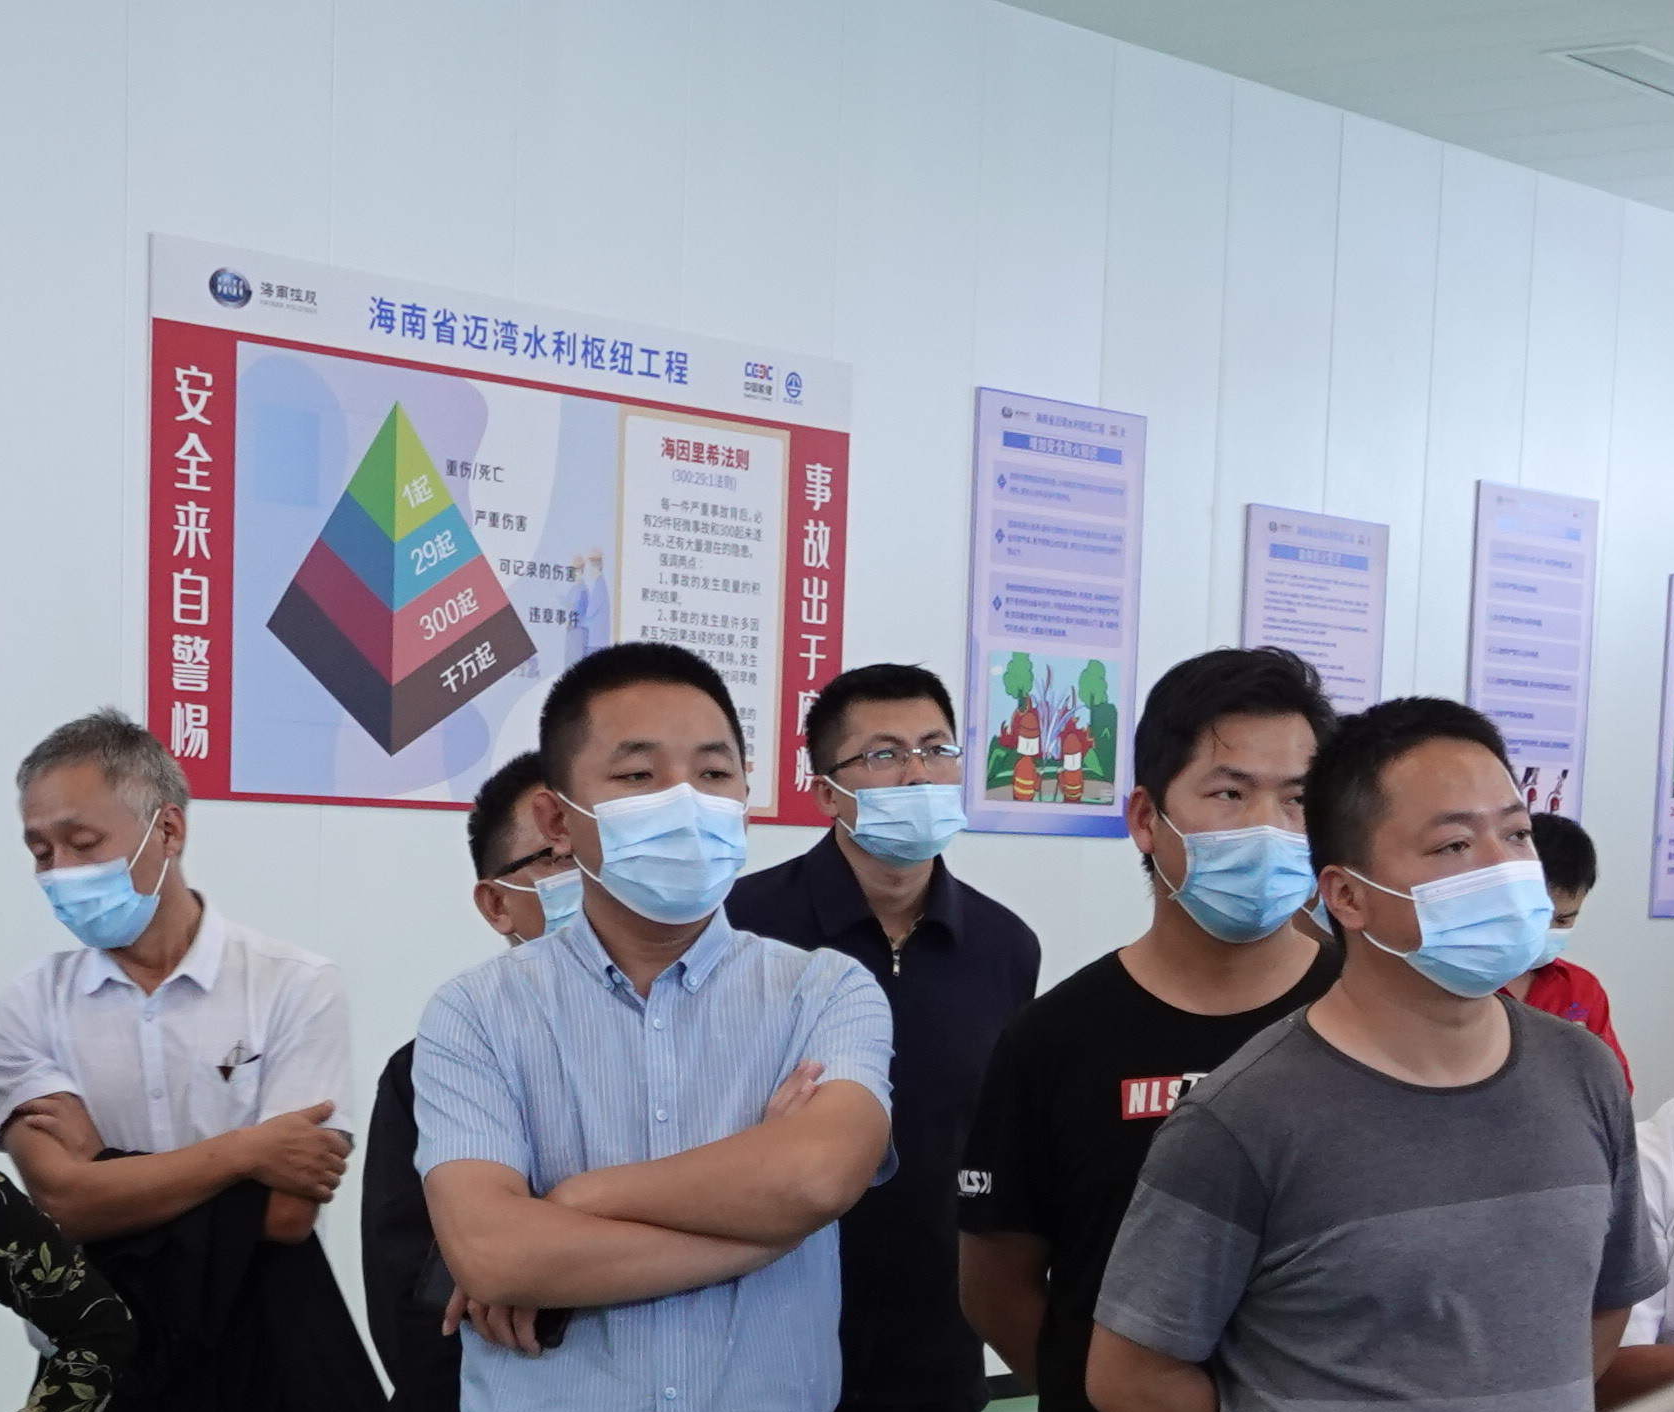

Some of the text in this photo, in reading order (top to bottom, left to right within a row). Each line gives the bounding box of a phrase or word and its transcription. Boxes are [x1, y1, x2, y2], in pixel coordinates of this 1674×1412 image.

[368, 296, 689, 386] 海南省迈湾水利枢纽工程
[445, 459, 505, 483] 重伤/死亡
[660, 437, 750, 471] 海因里希法则
[474, 509, 528, 532] 严重伤害
[170, 365, 214, 762] 安全来自警惕
[410, 529, 458, 576] 29起
[498, 558, 578, 583] 可记录的伤害
[419, 587, 480, 642] 300起
[529, 606, 581, 628] 违章事件
[439, 641, 497, 693] 千万起
